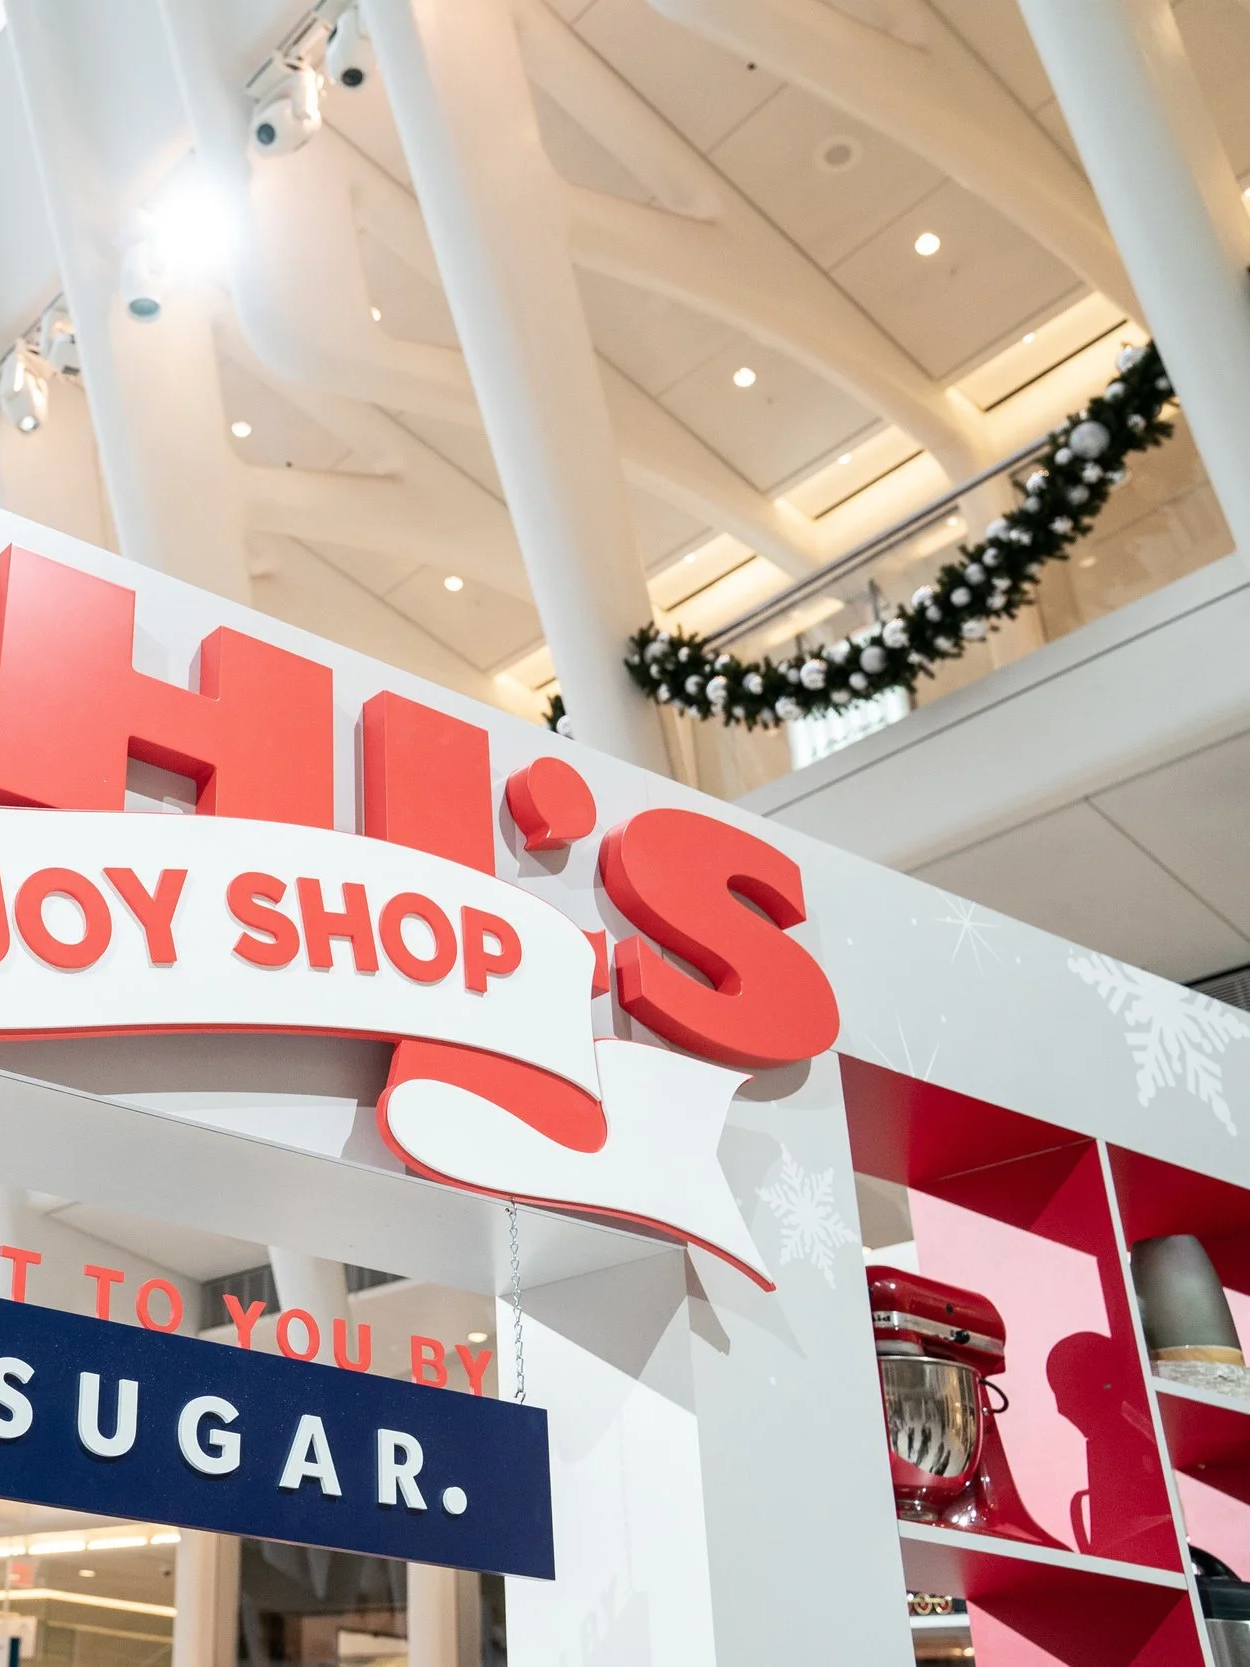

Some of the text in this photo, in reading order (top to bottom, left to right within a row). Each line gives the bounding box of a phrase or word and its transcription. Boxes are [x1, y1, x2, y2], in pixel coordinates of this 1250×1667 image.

[226, 871, 523, 997] SHOP
[83, 1264, 184, 1334] TO
[222, 1294, 372, 1374] YOU
[411, 1335, 493, 1397] BY
